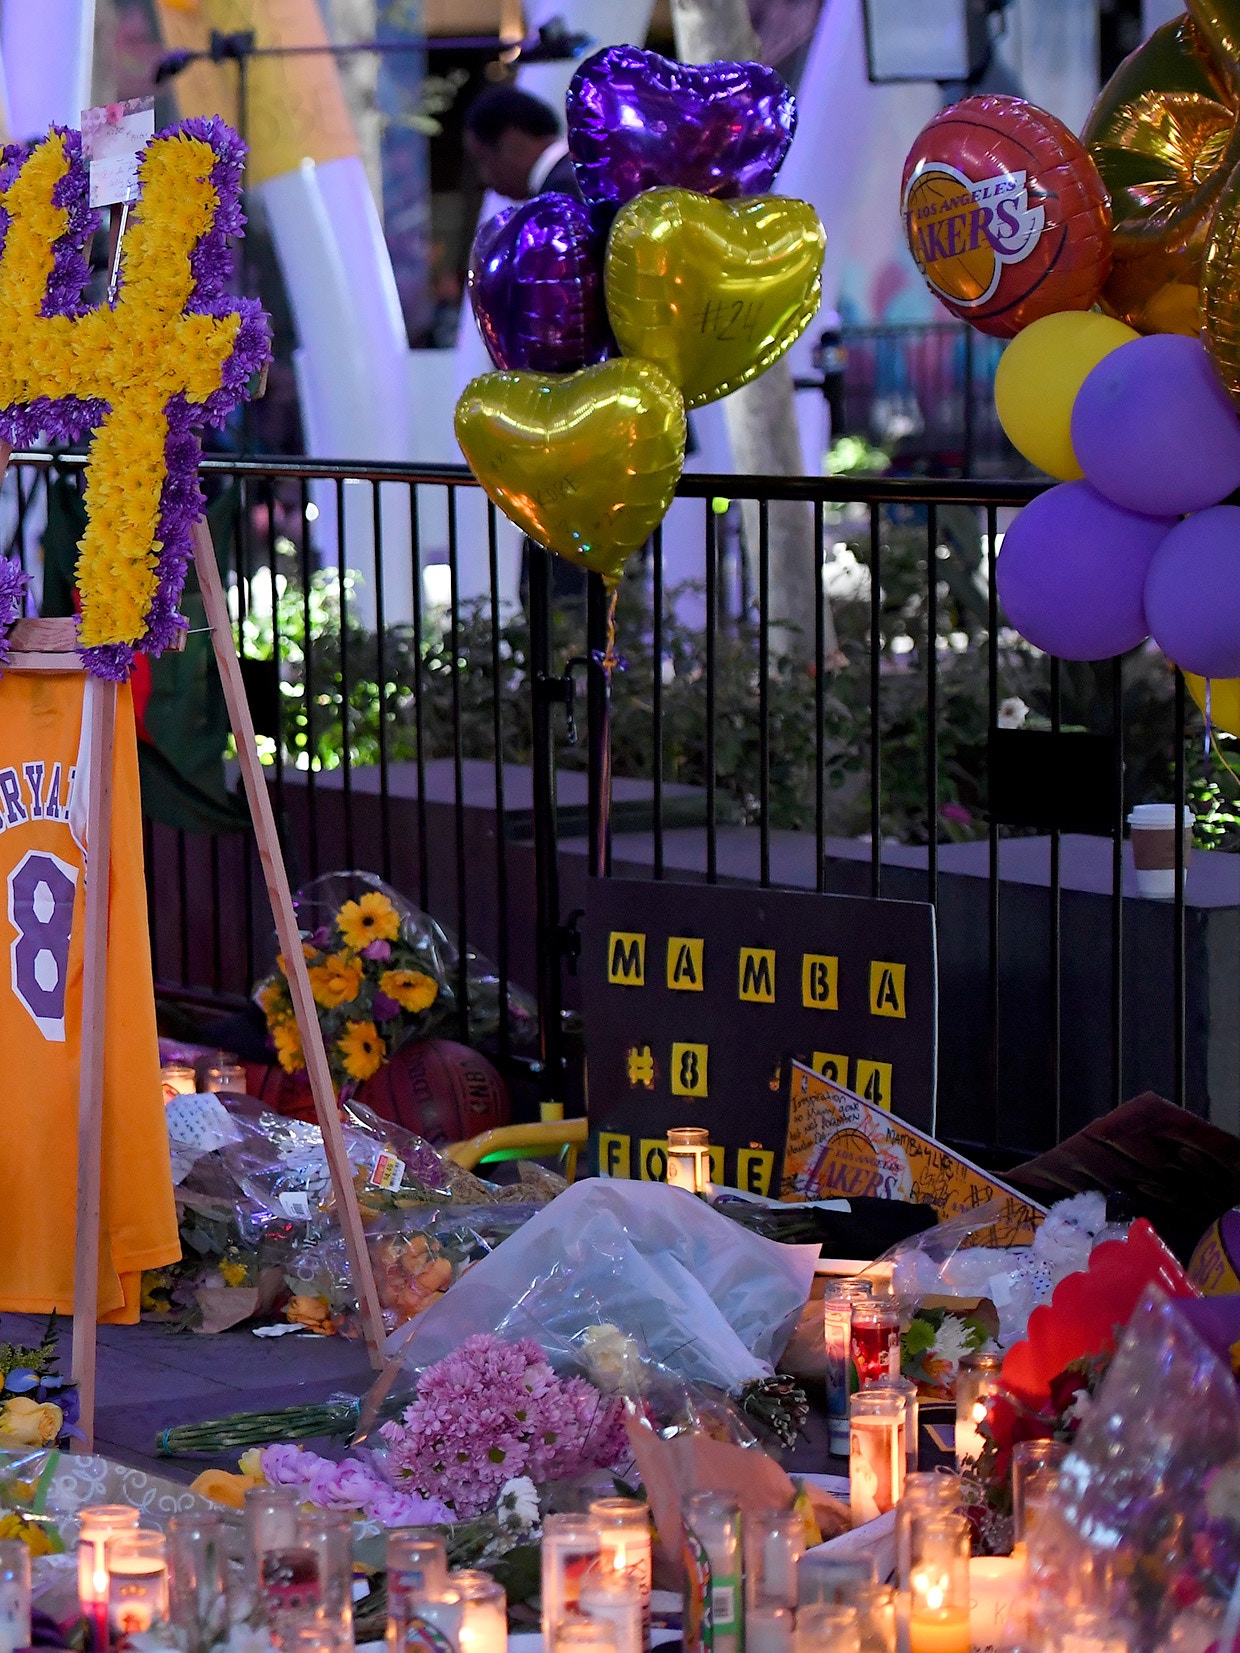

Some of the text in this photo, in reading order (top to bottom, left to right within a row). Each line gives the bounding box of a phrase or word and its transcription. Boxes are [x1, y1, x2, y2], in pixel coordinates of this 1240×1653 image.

[917, 179, 1018, 220] LOS ANGELES
[906, 198, 1036, 264] LAKERS
[694, 300, 765, 342] #24
[7, 850, 79, 1042] 8
[611, 938, 900, 1012] MAMBA
[627, 1046, 699, 1091] #8
[608, 1136, 764, 1196] FOE
[804, 1147, 899, 1200] LAKERS
